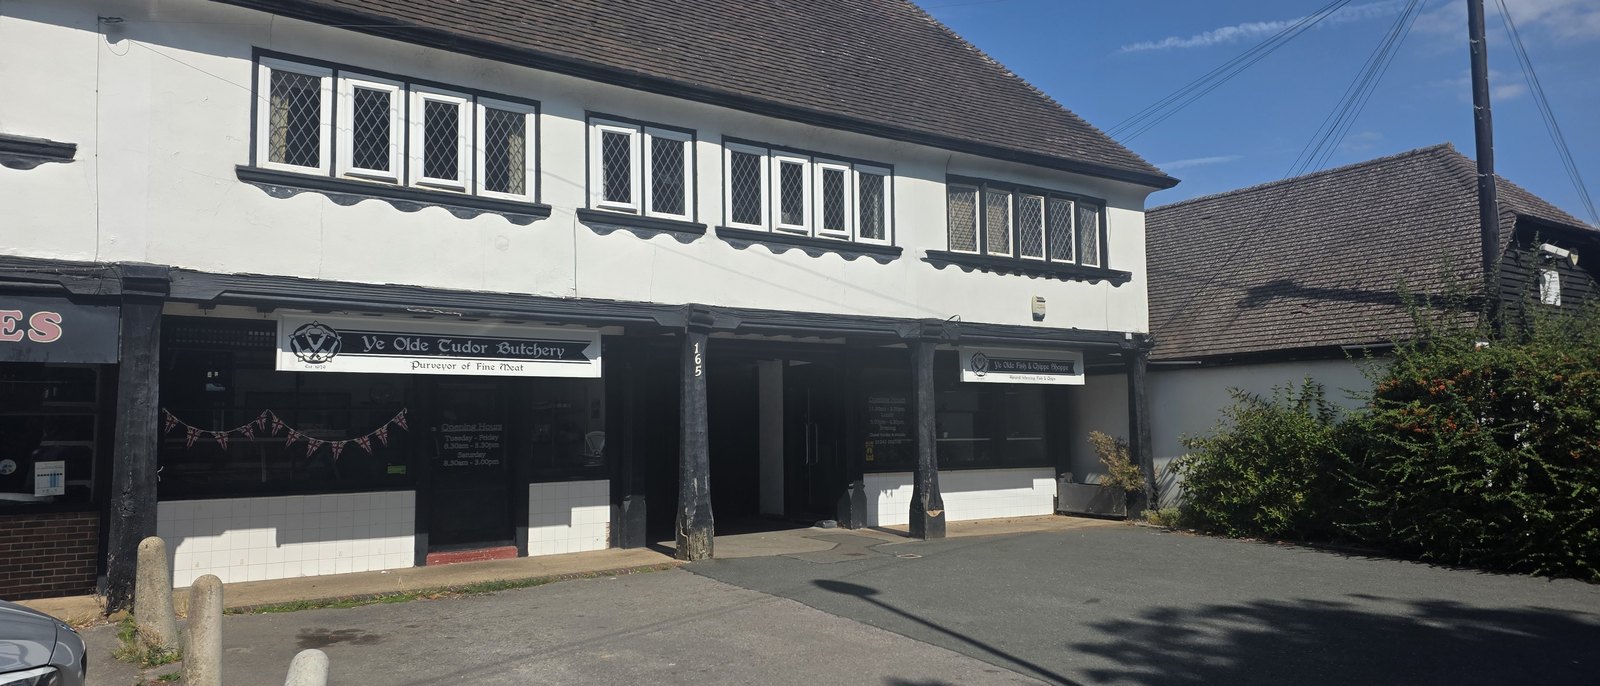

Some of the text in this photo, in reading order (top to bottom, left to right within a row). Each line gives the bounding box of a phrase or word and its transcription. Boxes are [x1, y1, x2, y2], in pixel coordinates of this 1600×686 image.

[0, 309, 63, 343] ES
[361, 335, 565, 359] Ye Olde Tudor Butchery
[410, 360, 524, 372] Purveyor of Fine Meat
[694, 342, 702, 377] 165
[1002, 361, 1015, 369] Olde
[441, 422, 503, 432] Opening Hours
